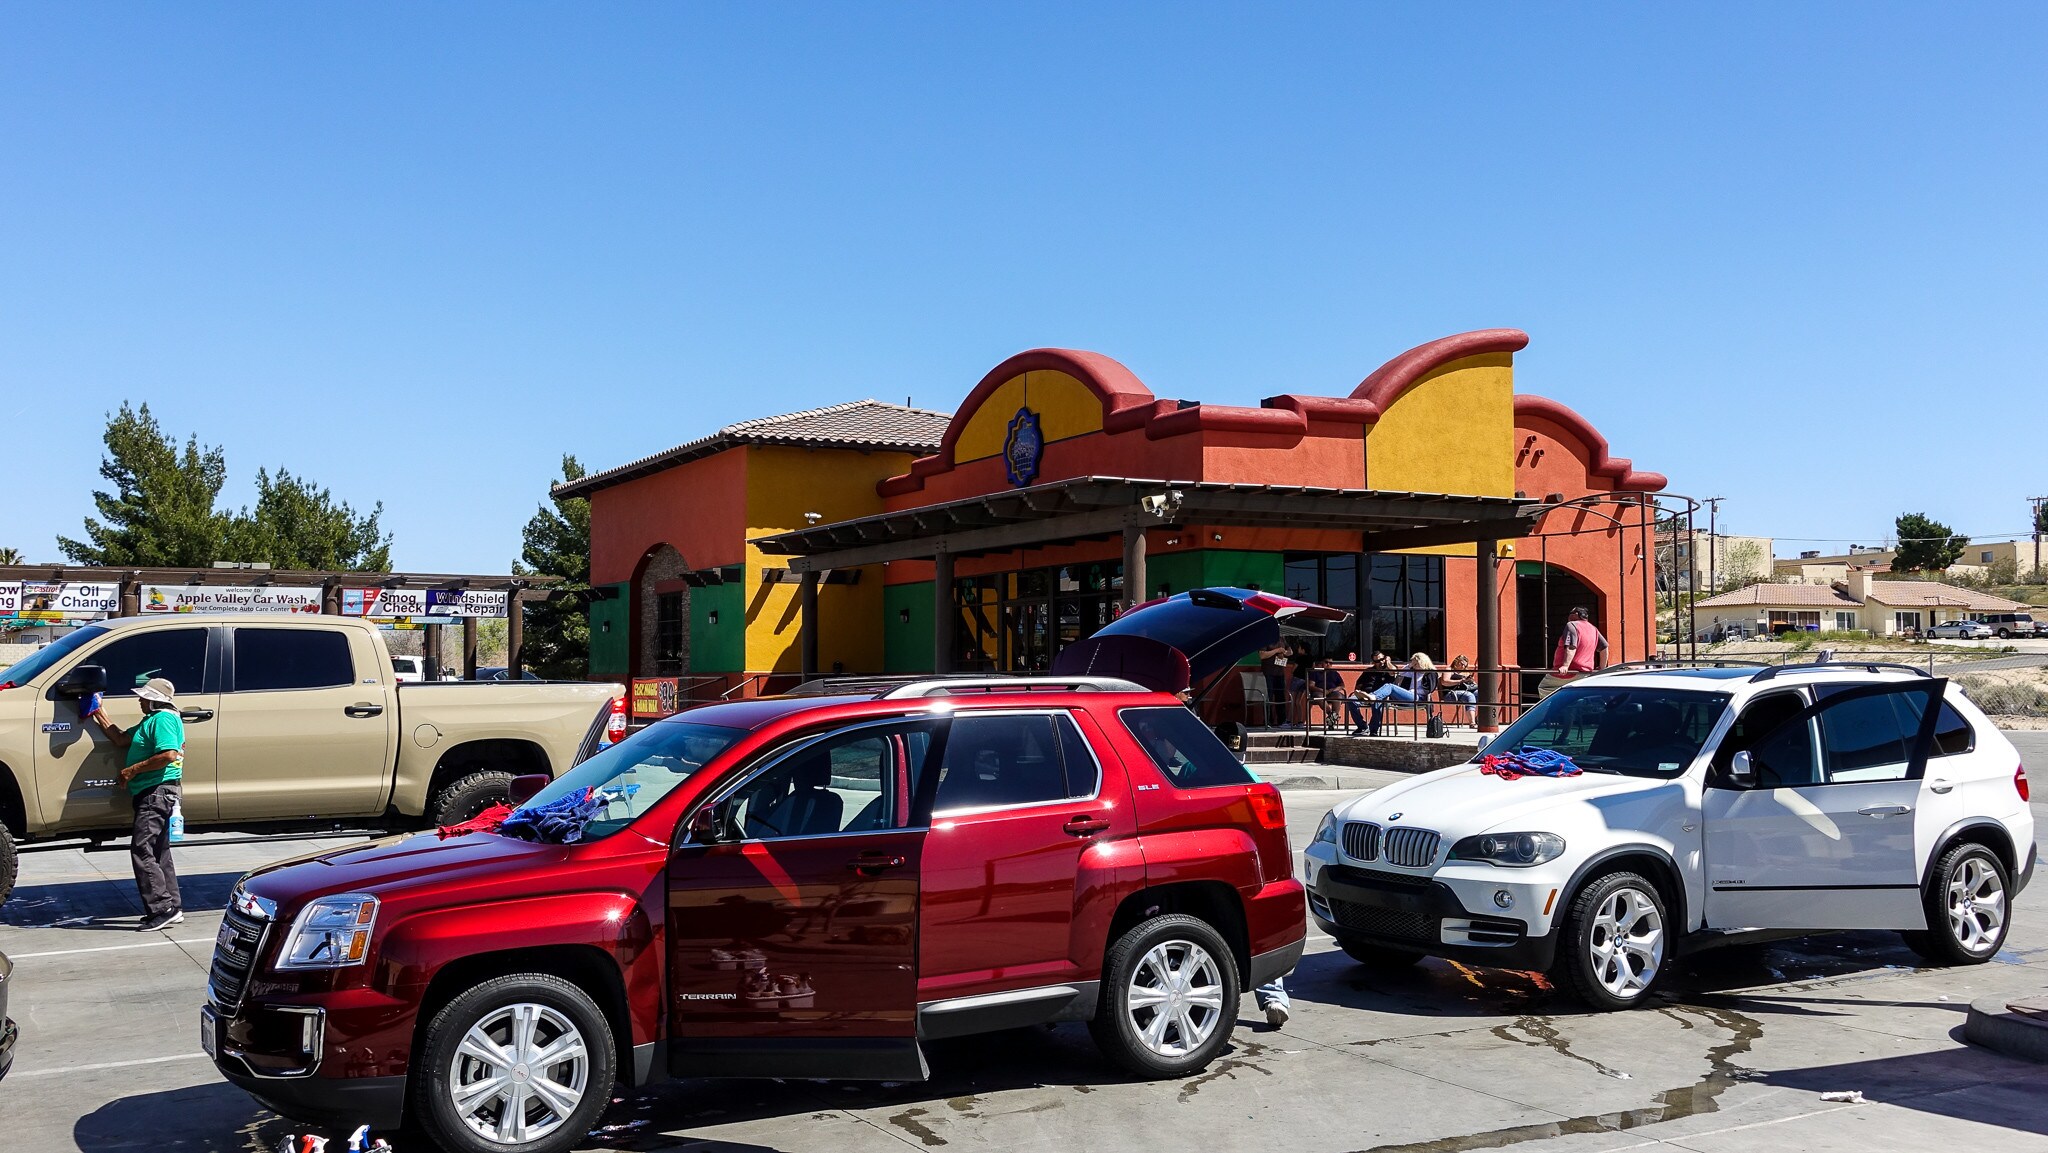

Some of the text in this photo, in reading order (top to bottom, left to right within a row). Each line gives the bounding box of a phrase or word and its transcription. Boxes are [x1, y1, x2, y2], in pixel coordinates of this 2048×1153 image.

[79, 585, 100, 597] Oil
[61, 596, 117, 610] Change
[175, 593, 308, 606] Apple Valley Car Wash
[380, 591, 417, 605] Smog
[435, 591, 506, 604] Windshield
[208, 605, 238, 613] Complete
[383, 602, 423, 614] Check
[464, 604, 505, 615] Repair
[84, 779, 117, 787] TUN
